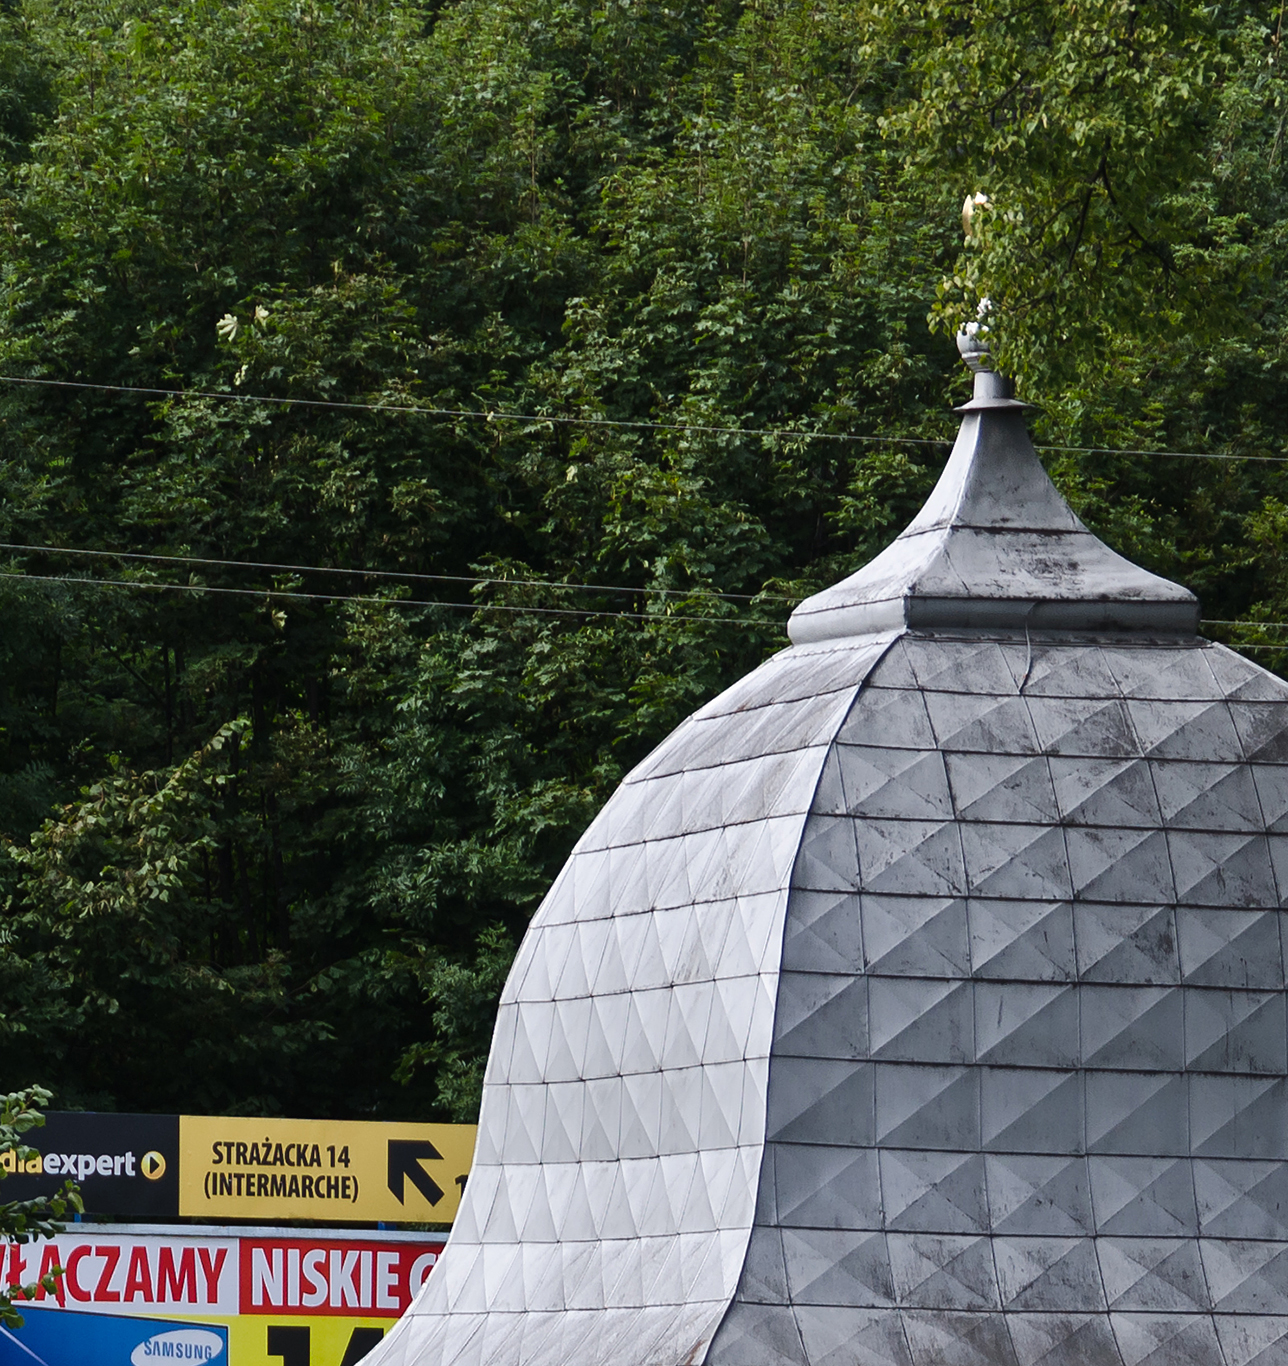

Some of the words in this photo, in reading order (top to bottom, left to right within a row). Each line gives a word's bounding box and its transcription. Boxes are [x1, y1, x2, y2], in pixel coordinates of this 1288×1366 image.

[212, 1137, 321, 1168] STRAŻACKA
[326, 1145, 350, 1168] 14
[204, 1171, 359, 1203] (INTERMARCHE)
[251, 1247, 400, 1309] NISKIE
[144, 1340, 212, 1360] SAMSUNG
